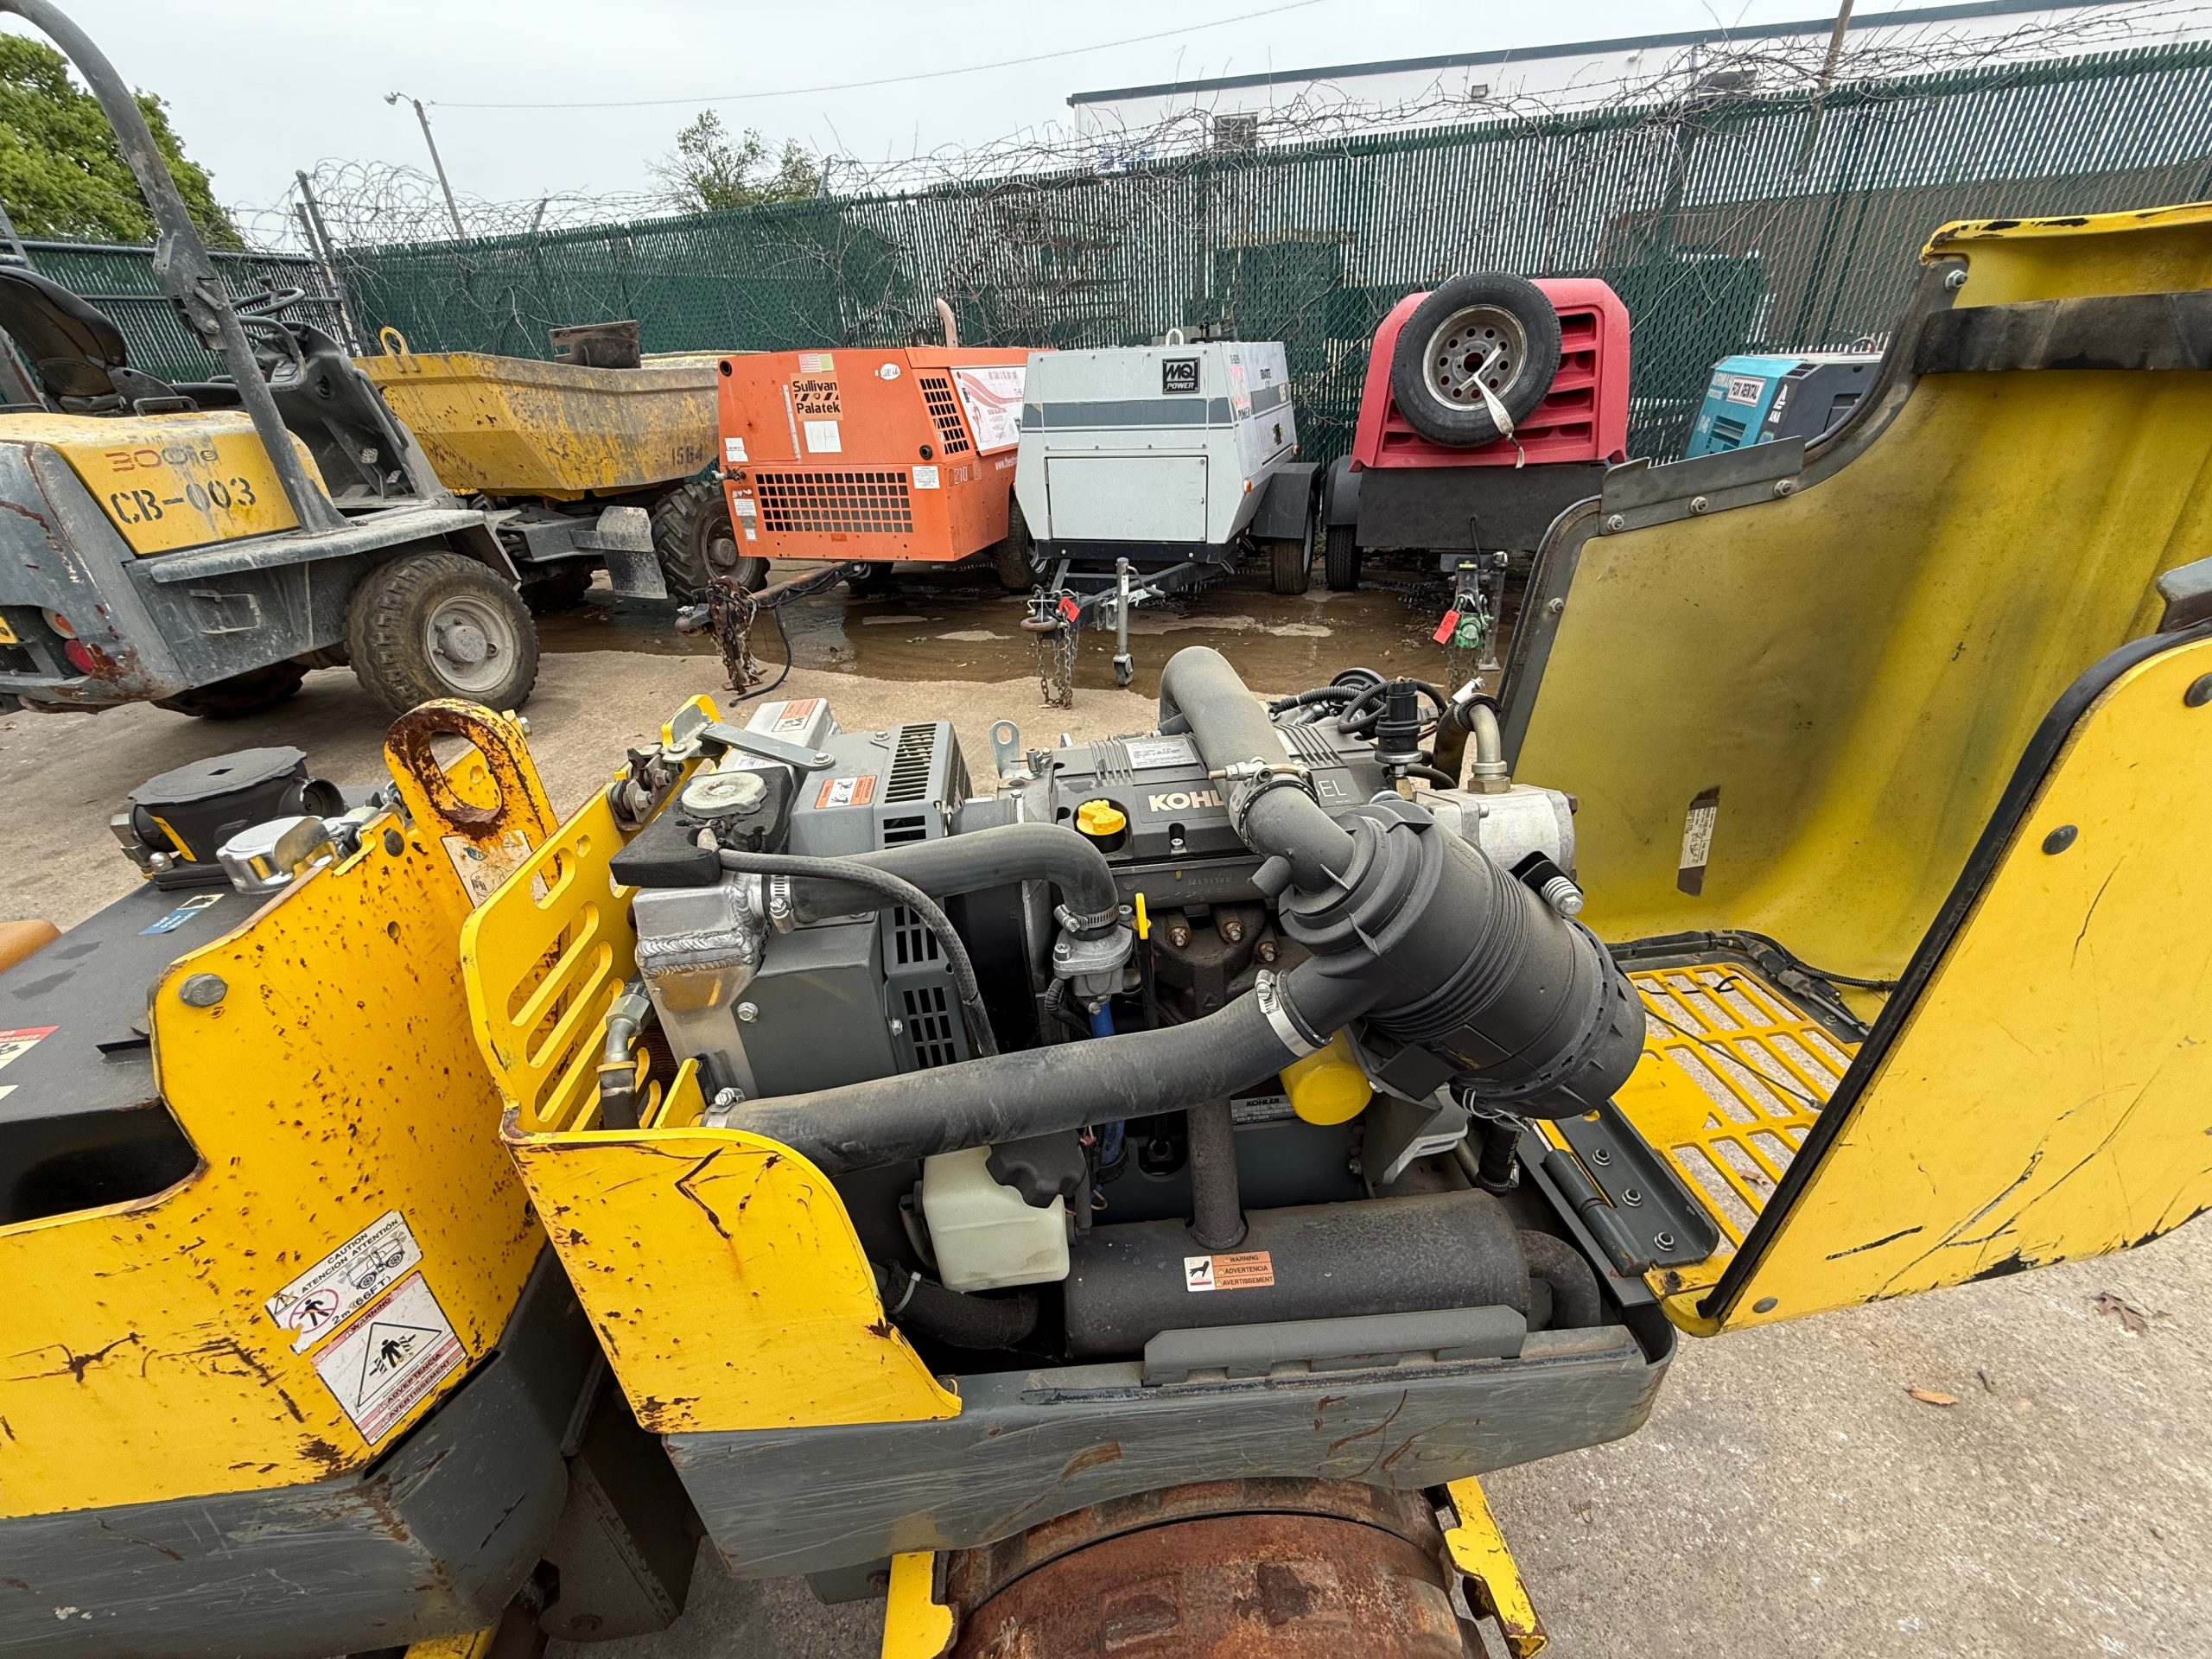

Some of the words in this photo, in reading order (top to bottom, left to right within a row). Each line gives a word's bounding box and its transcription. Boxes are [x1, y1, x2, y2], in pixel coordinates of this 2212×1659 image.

[1166, 364, 1194, 379] MQ
[792, 380, 838, 392] Sullivan
[796, 403, 841, 414] Palatek
[110, 477, 257, 524] CB-003
[1148, 791, 1224, 812] KOHL
[327, 1233, 368, 1264] CAUTION
[302, 1257, 348, 1294] ATENCION
[1223, 1276, 1273, 1286] AVERTISSEMENT
[1224, 1266, 1268, 1274] ADVERTENCIA
[351, 1298, 393, 1332] WARNING
[387, 1353, 442, 1403] ADVERTENCIA
[389, 1359, 451, 1419] AVERTISSEMENT
